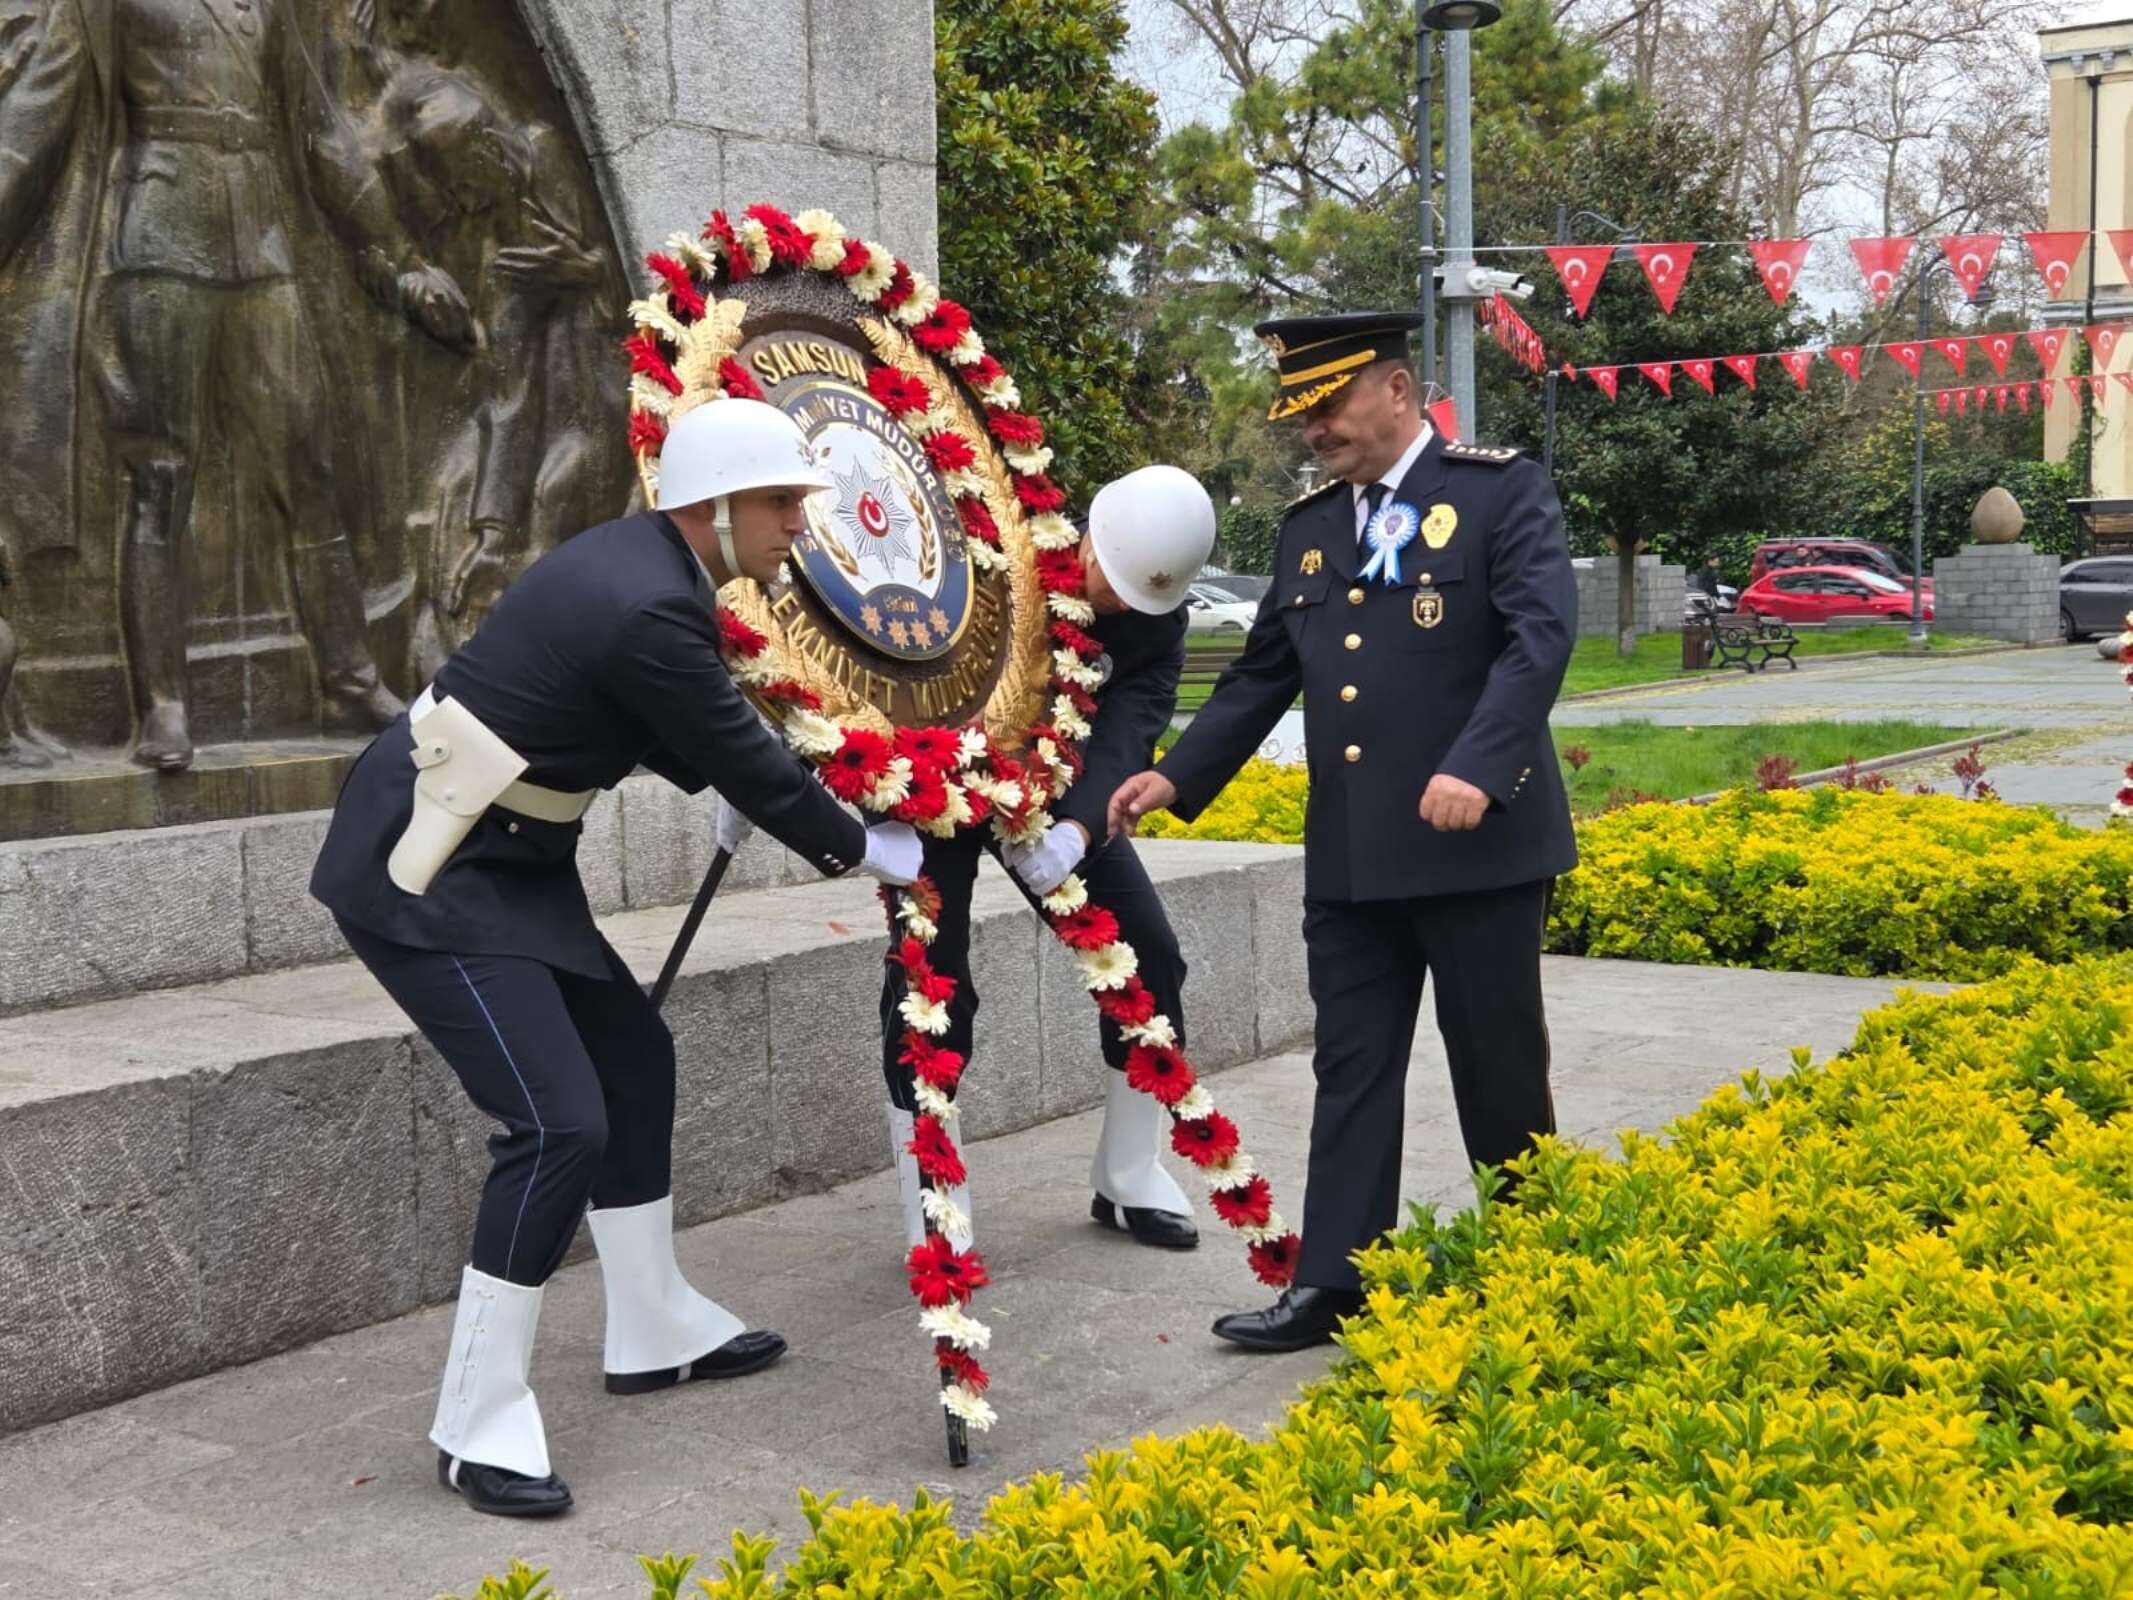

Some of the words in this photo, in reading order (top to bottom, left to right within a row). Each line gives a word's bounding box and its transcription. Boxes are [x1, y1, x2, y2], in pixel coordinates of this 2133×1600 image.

[752, 341, 868, 387] SAMSUN
[794, 394, 860, 432] MNİYET
[772, 591, 898, 713] EMNİYET
